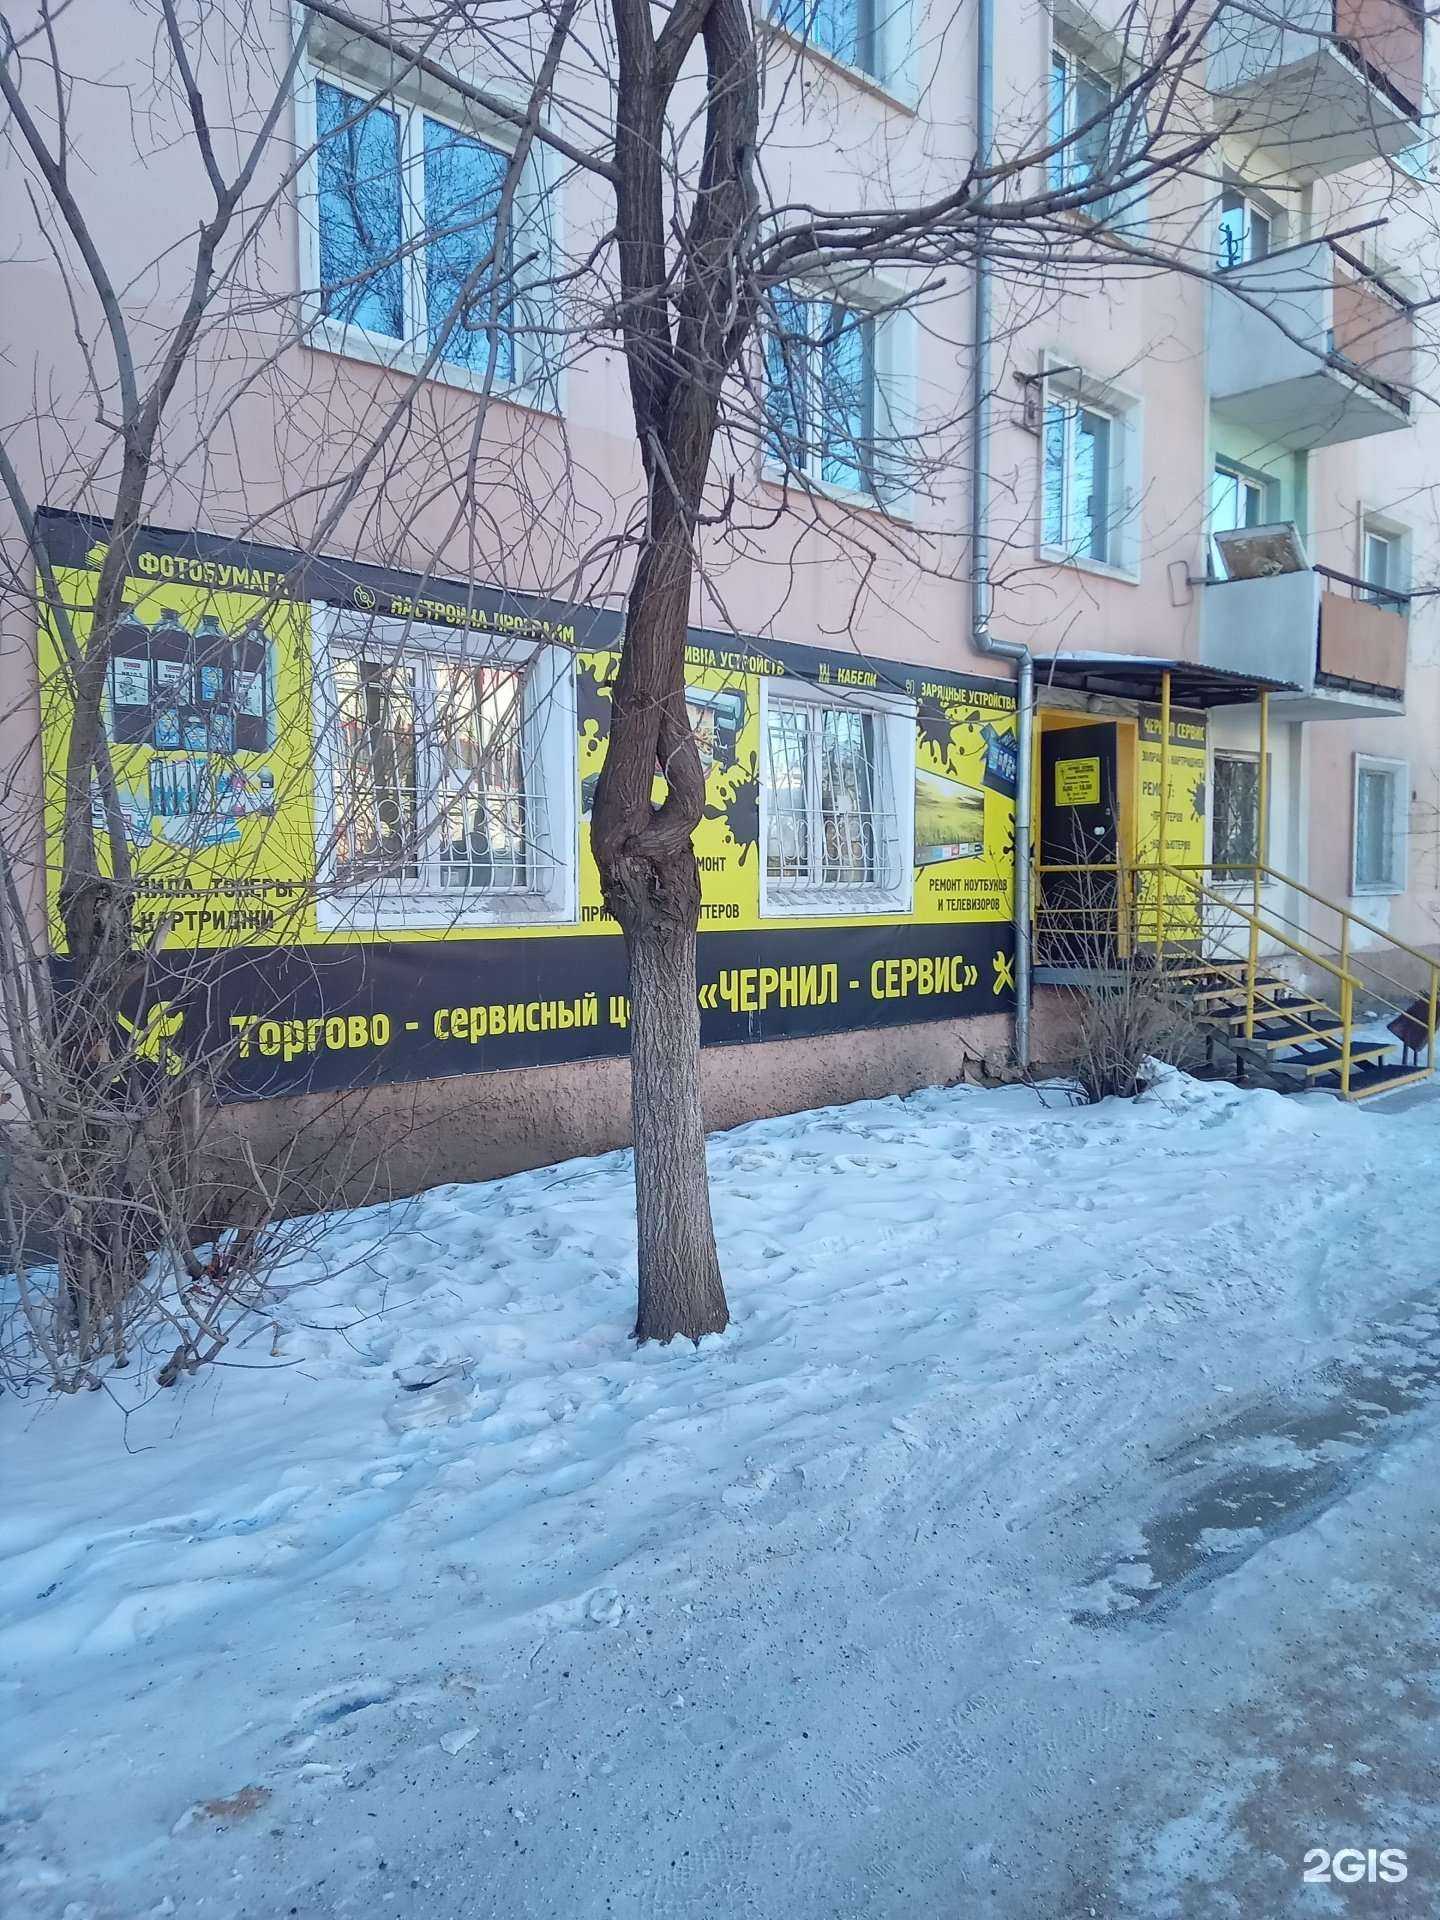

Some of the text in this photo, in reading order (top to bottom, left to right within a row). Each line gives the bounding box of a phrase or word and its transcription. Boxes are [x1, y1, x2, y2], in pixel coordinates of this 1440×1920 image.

[138, 551, 292, 595] ФОТОБУМАГА
[720, 651, 785, 676] УСТРОЙСТВ
[837, 667, 877, 687] КАБЕЛИ
[921, 682, 1016, 710] ЗАРЯДНЫЕ УСТРОЙСТВА
[1177, 723, 1205, 741] СЕРВИС
[929, 878, 1007, 891] РЕМОНТ НОУТБУКОВ
[938, 898, 1000, 911] И ТЕЛЕВИЗОРОВ
[229, 1012, 390, 1062] Торгово
[433, 991, 599, 1043] сервисный
[698, 963, 838, 1012] «ЧЕРНИЛ
[871, 955, 978, 999] СЕРВИС»
